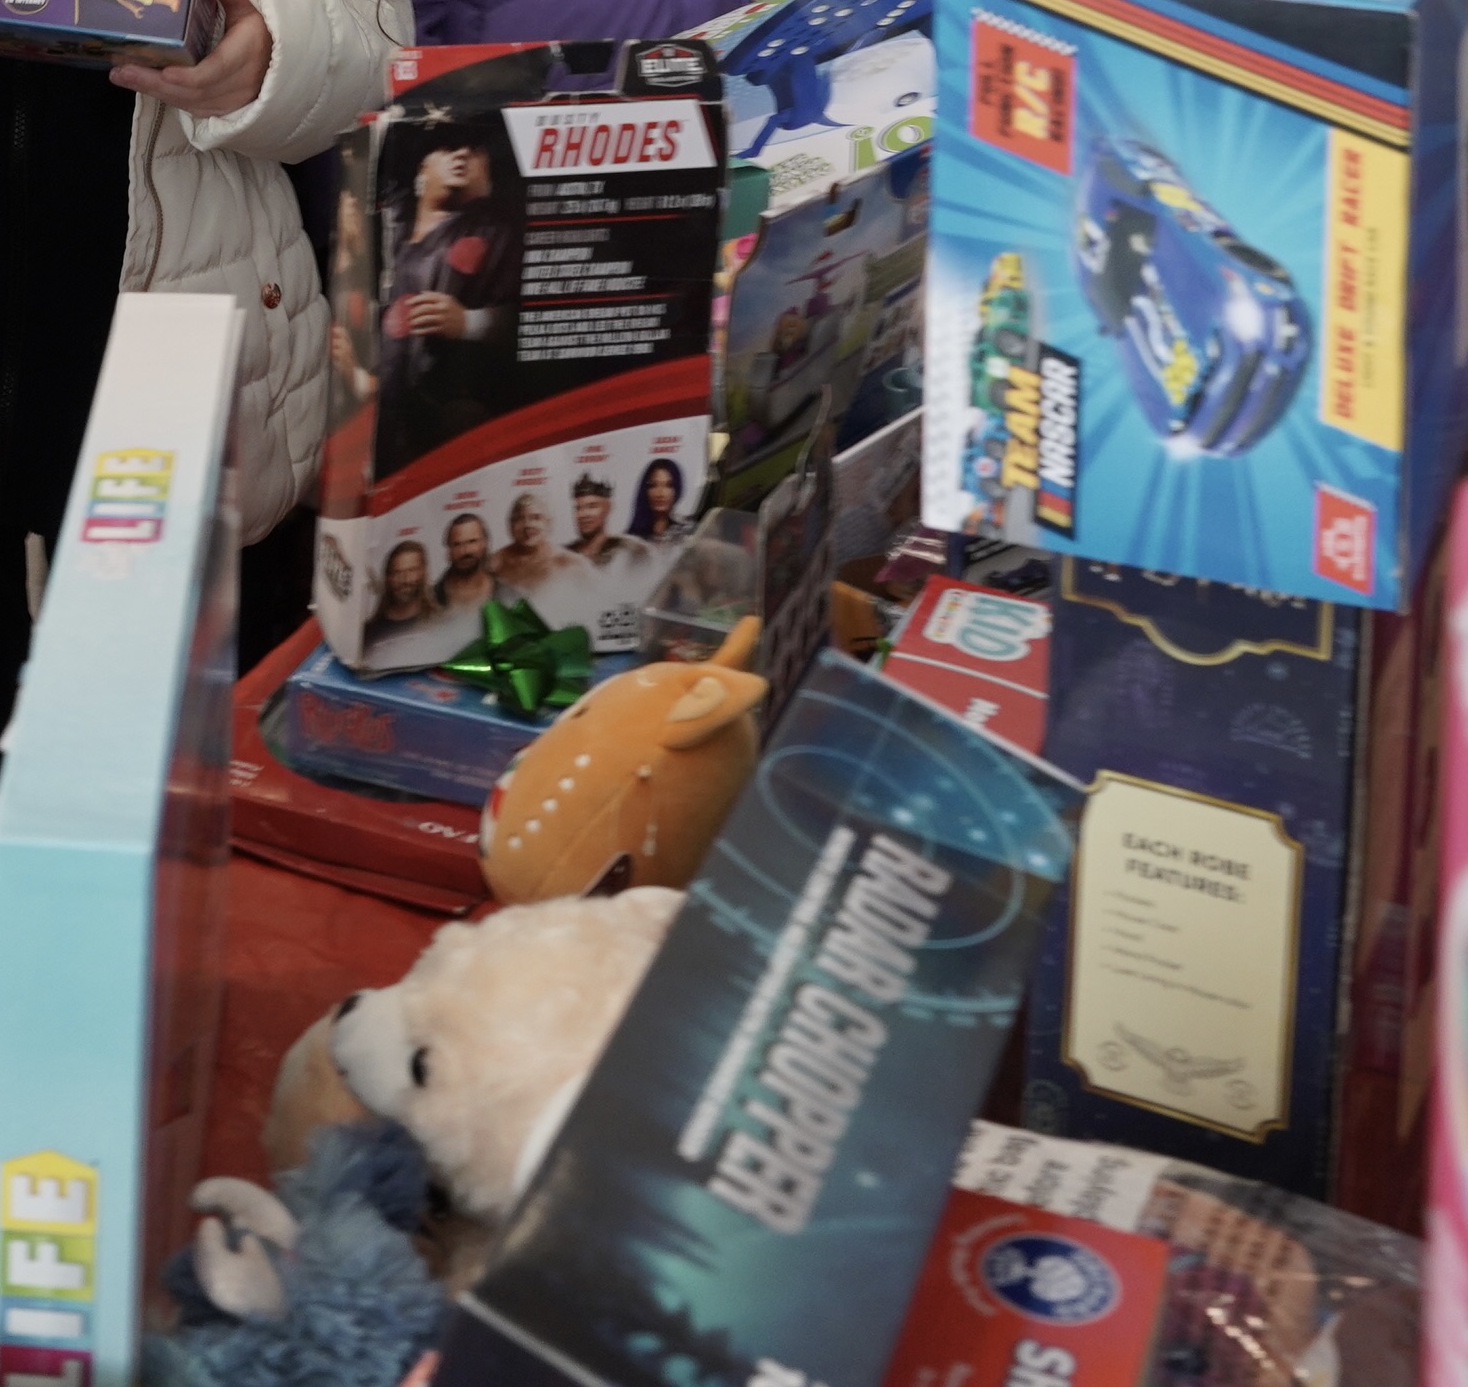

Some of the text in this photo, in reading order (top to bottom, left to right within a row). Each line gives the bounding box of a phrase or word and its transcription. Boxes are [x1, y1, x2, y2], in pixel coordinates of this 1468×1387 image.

[531, 120, 680, 170] RHODES
[1013, 60, 1051, 140] R/C
[1334, 146, 1363, 421] DELUXE DRIFT RACER
[1001, 365, 1042, 491] TEAM
[1038, 357, 1078, 489] NASCAR
[84, 450, 173, 540] LIFE
[957, 595, 1039, 658] KID
[816, 831, 953, 1004] RADAR
[1121, 832, 1250, 878] EACH ROBE
[710, 982, 890, 1235] CHOPPER
[3, 1172, 95, 1387] LIFE
